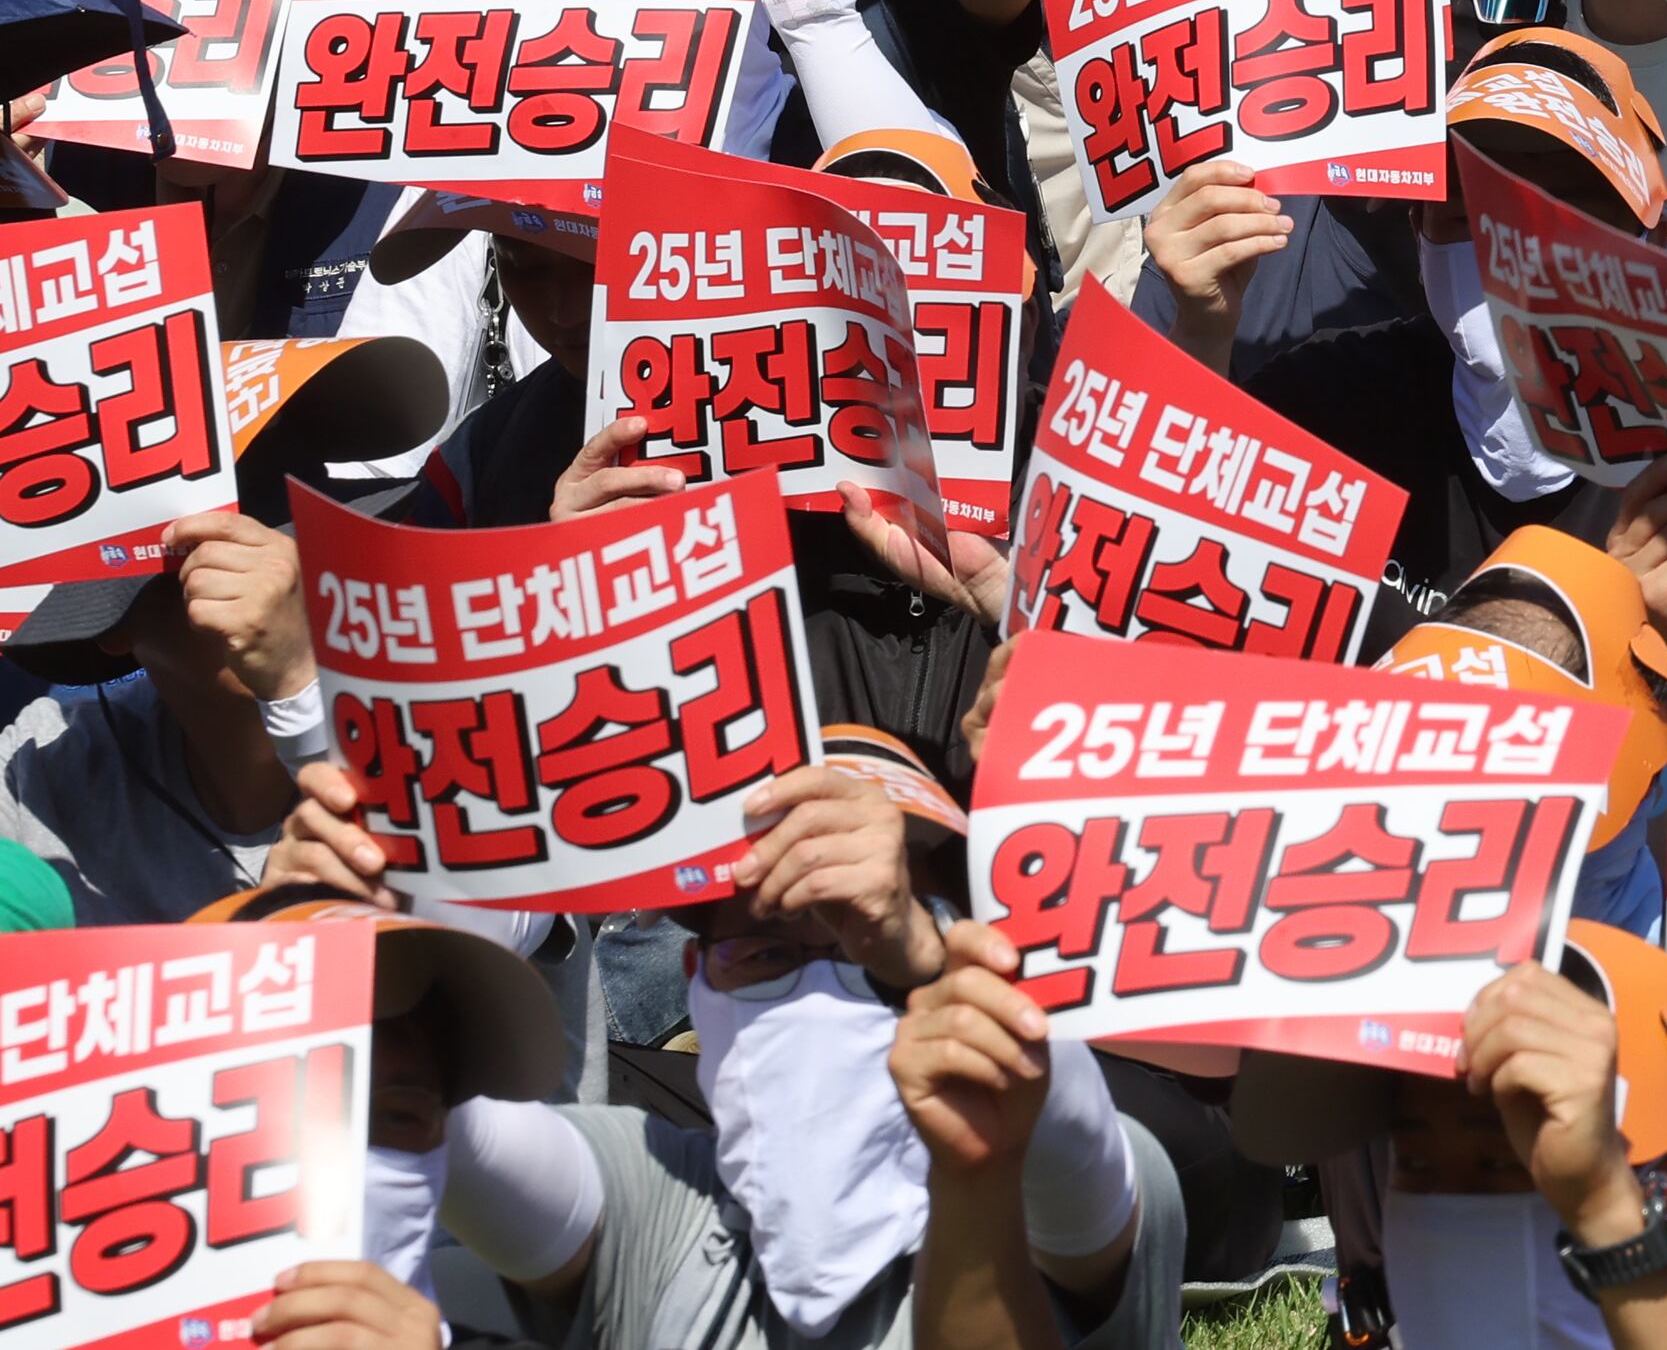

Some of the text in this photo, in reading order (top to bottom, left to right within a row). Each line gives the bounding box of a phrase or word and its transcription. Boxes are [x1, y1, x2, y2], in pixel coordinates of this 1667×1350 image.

[295, 7, 738, 164] 완전승리
[1355, 168, 1434, 186] 현대자동차지부
[629, 229, 743, 301] 25년
[1051, 359, 1367, 556] 25년 단체교섭
[319, 495, 743, 665] 25년 단체교섭
[334, 587, 809, 870] 완전승리
[1019, 701, 1573, 781] 25년 단체교섭
[991, 796, 1581, 1014] 완전승리
